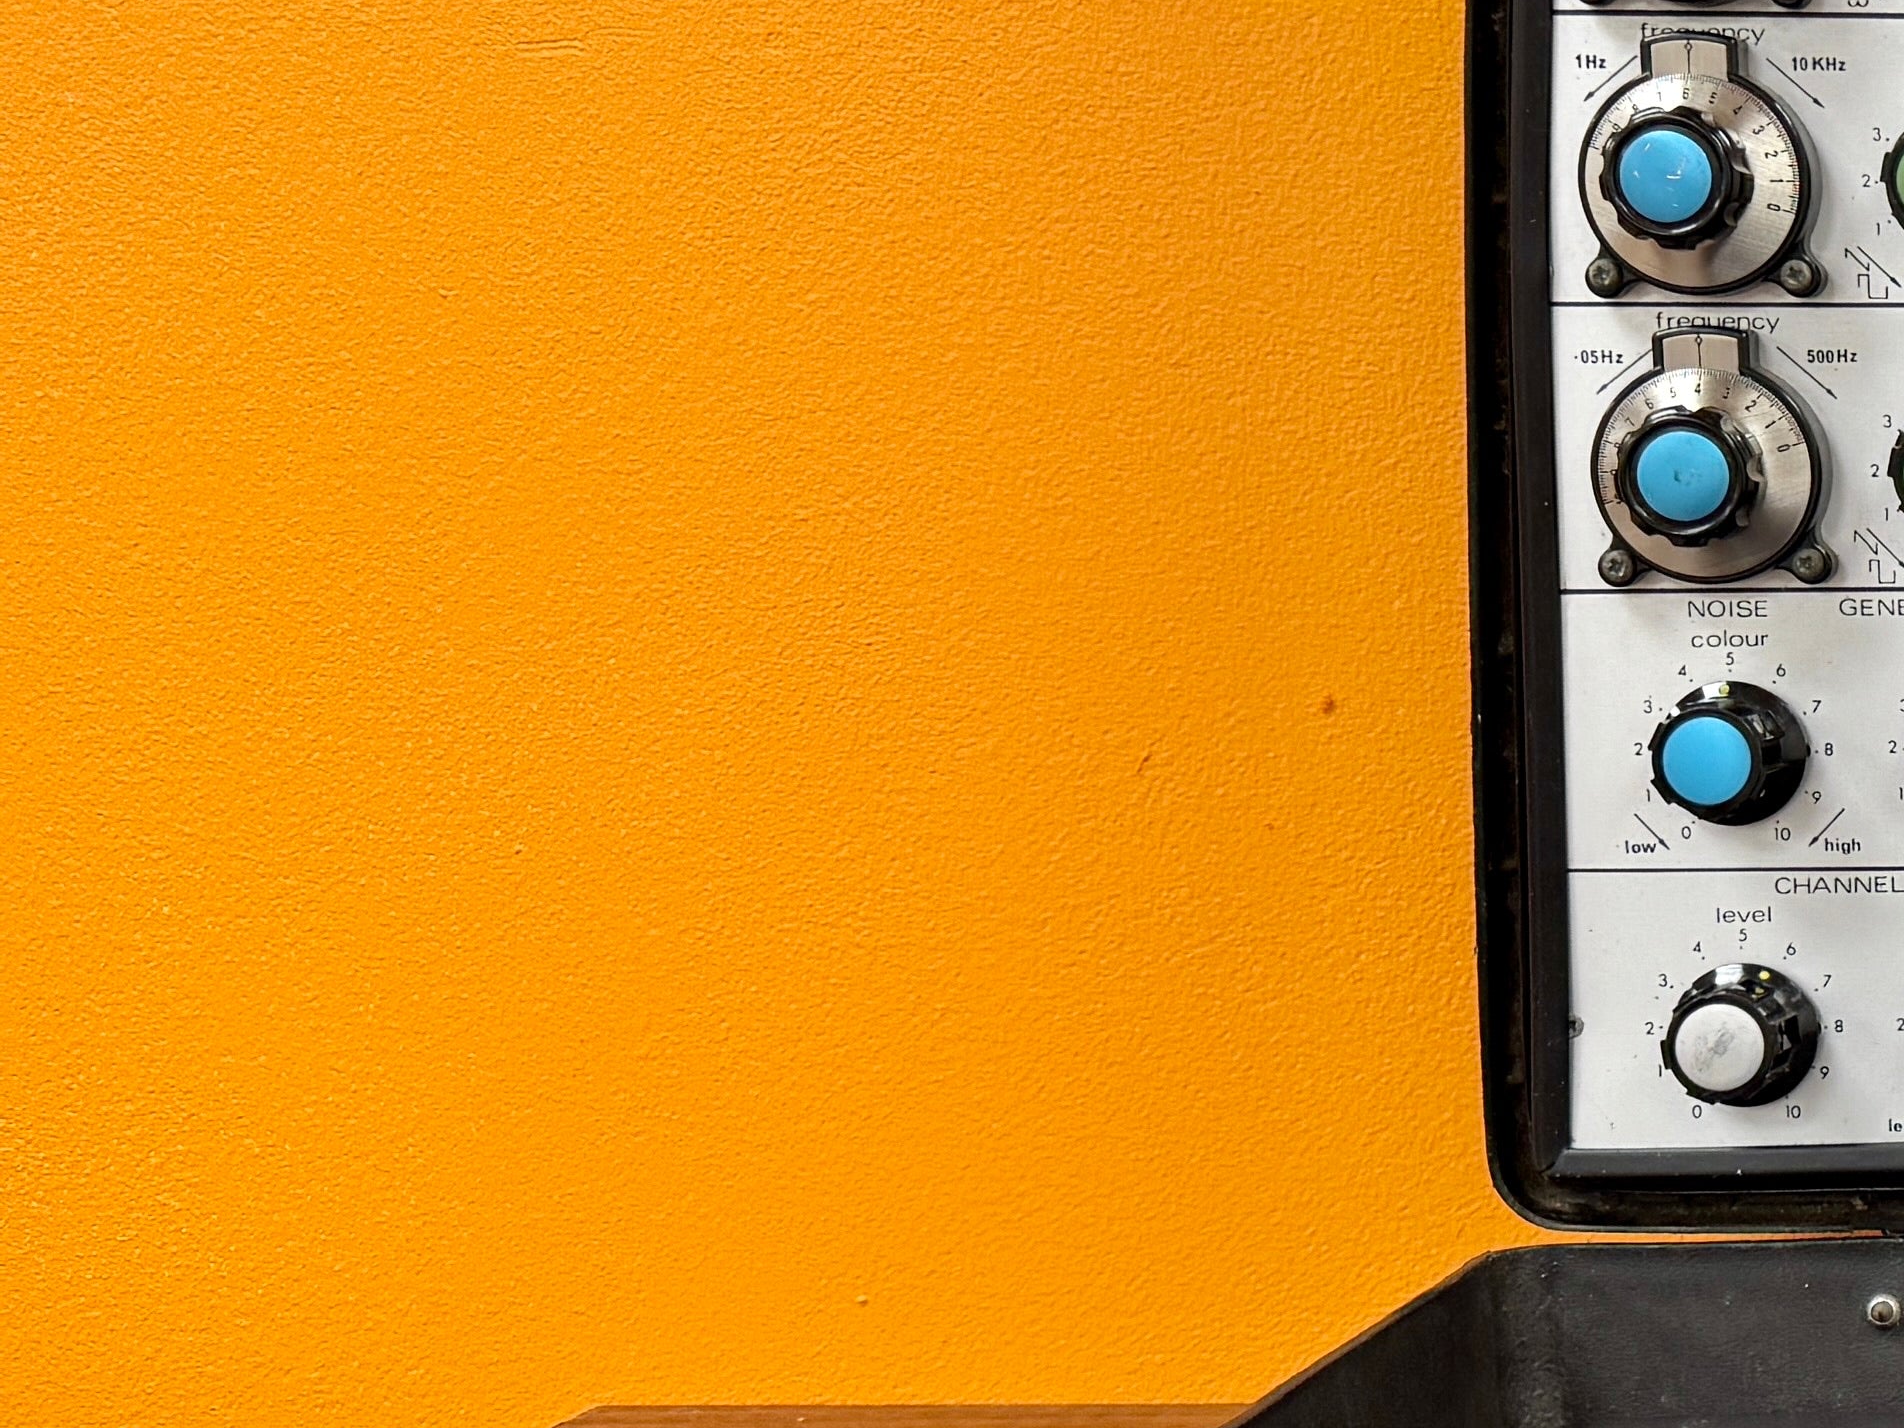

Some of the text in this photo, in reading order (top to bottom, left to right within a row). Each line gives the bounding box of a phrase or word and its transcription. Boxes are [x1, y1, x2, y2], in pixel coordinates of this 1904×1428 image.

[1688, 600, 1767, 617] NOISE
[1692, 630, 1768, 647] colour
[1625, 841, 1656, 853] low
[1825, 838, 1860, 854] high
[1775, 876, 1904, 894] CHANNEL
[1717, 906, 1771, 923] level
